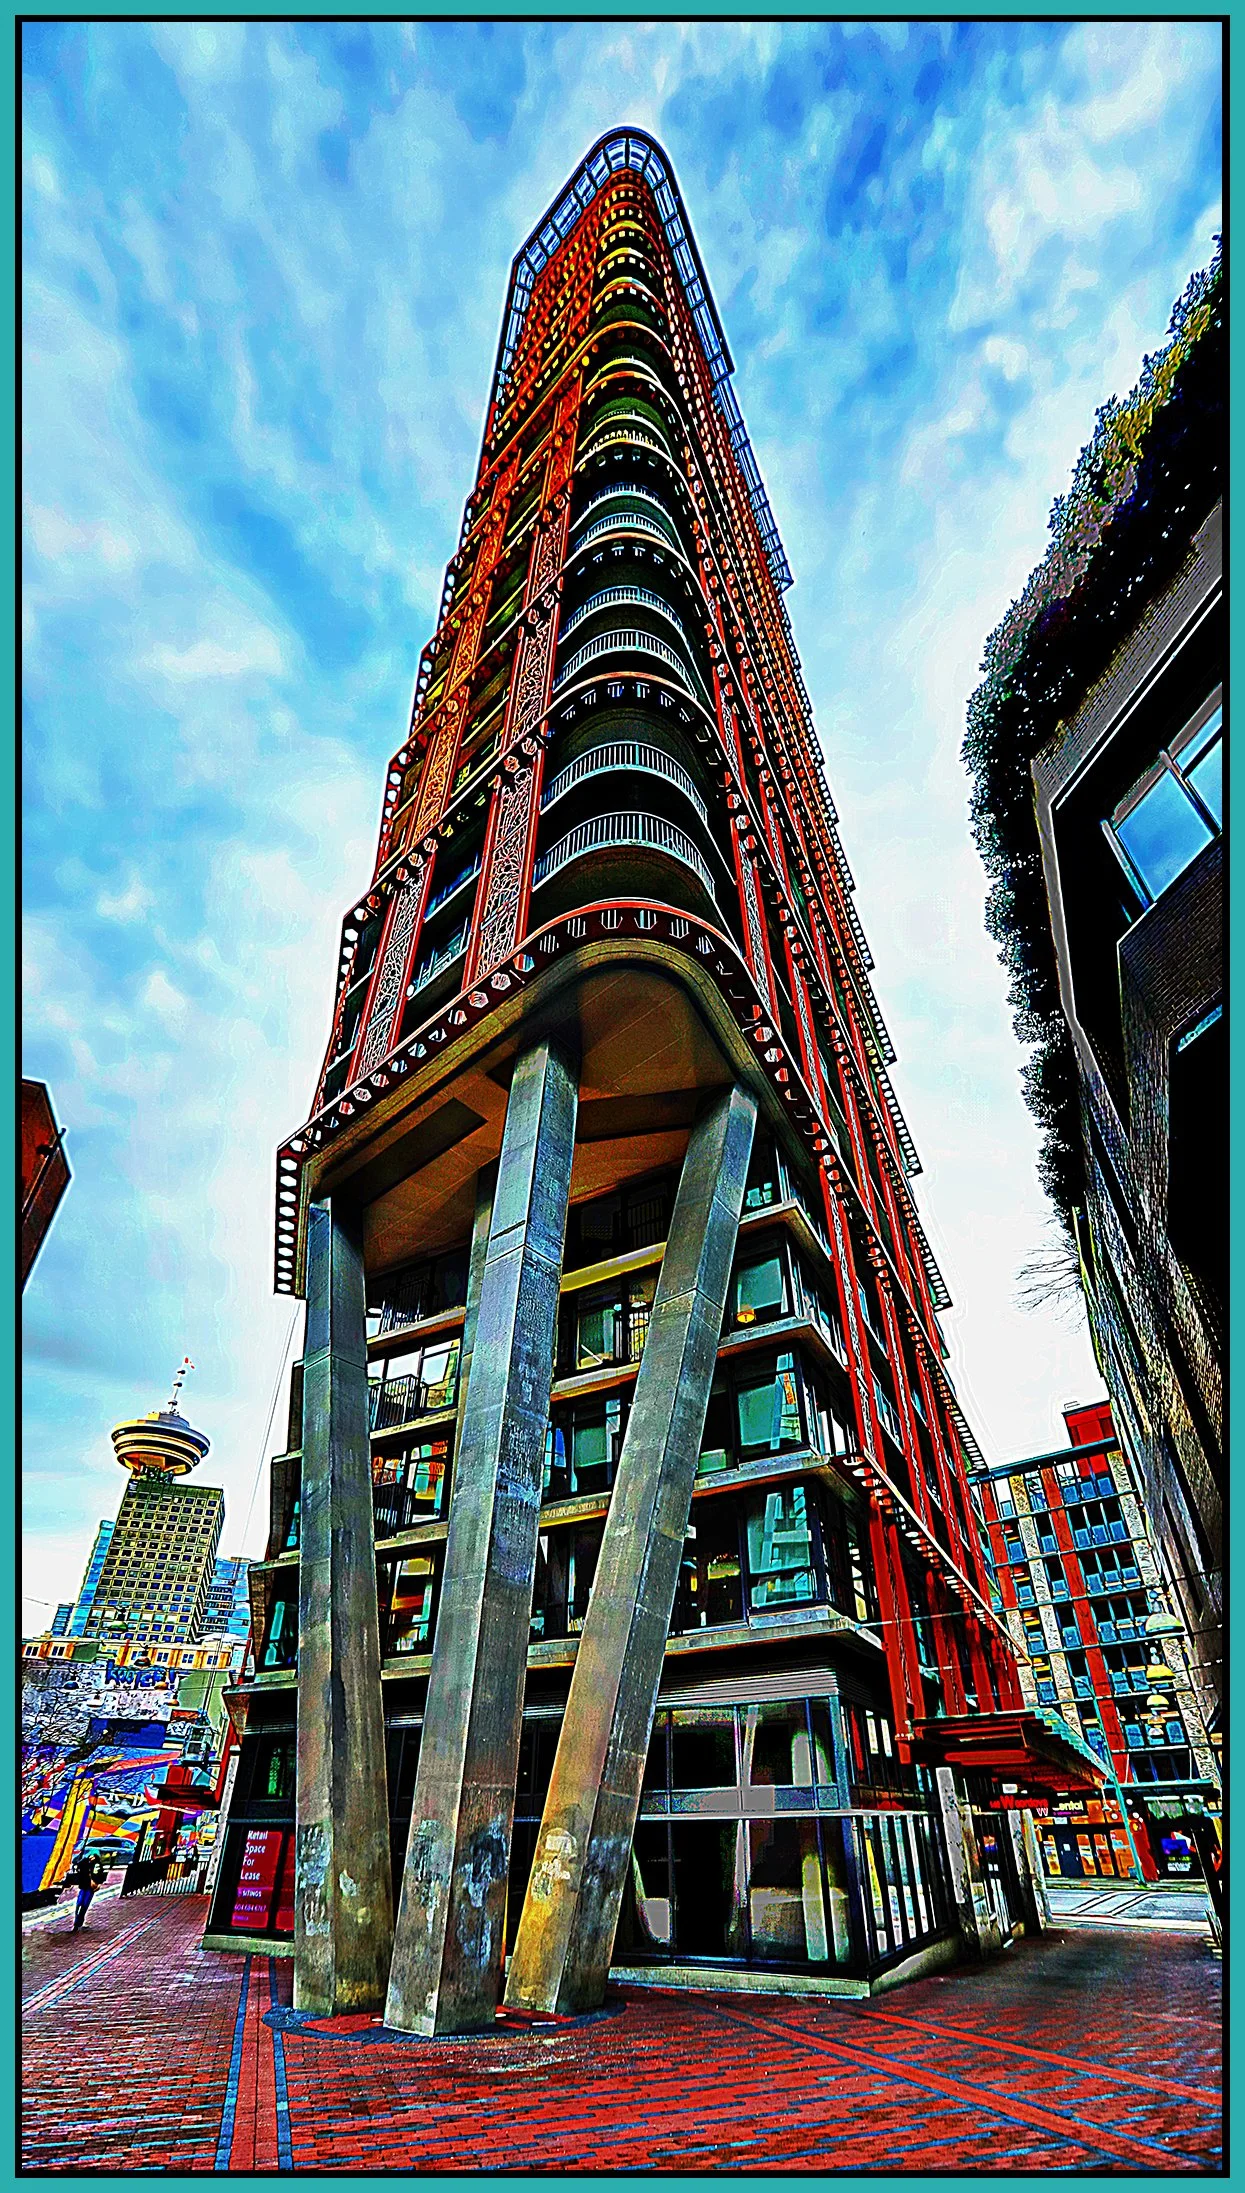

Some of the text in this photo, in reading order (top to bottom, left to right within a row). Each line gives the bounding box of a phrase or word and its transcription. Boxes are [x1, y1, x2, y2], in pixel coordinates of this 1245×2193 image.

[247, 1830, 269, 1840] Retail
[245, 1841, 266, 1855] Space
[242, 1856, 255, 1866] For
[240, 1869, 260, 1880] Lease
